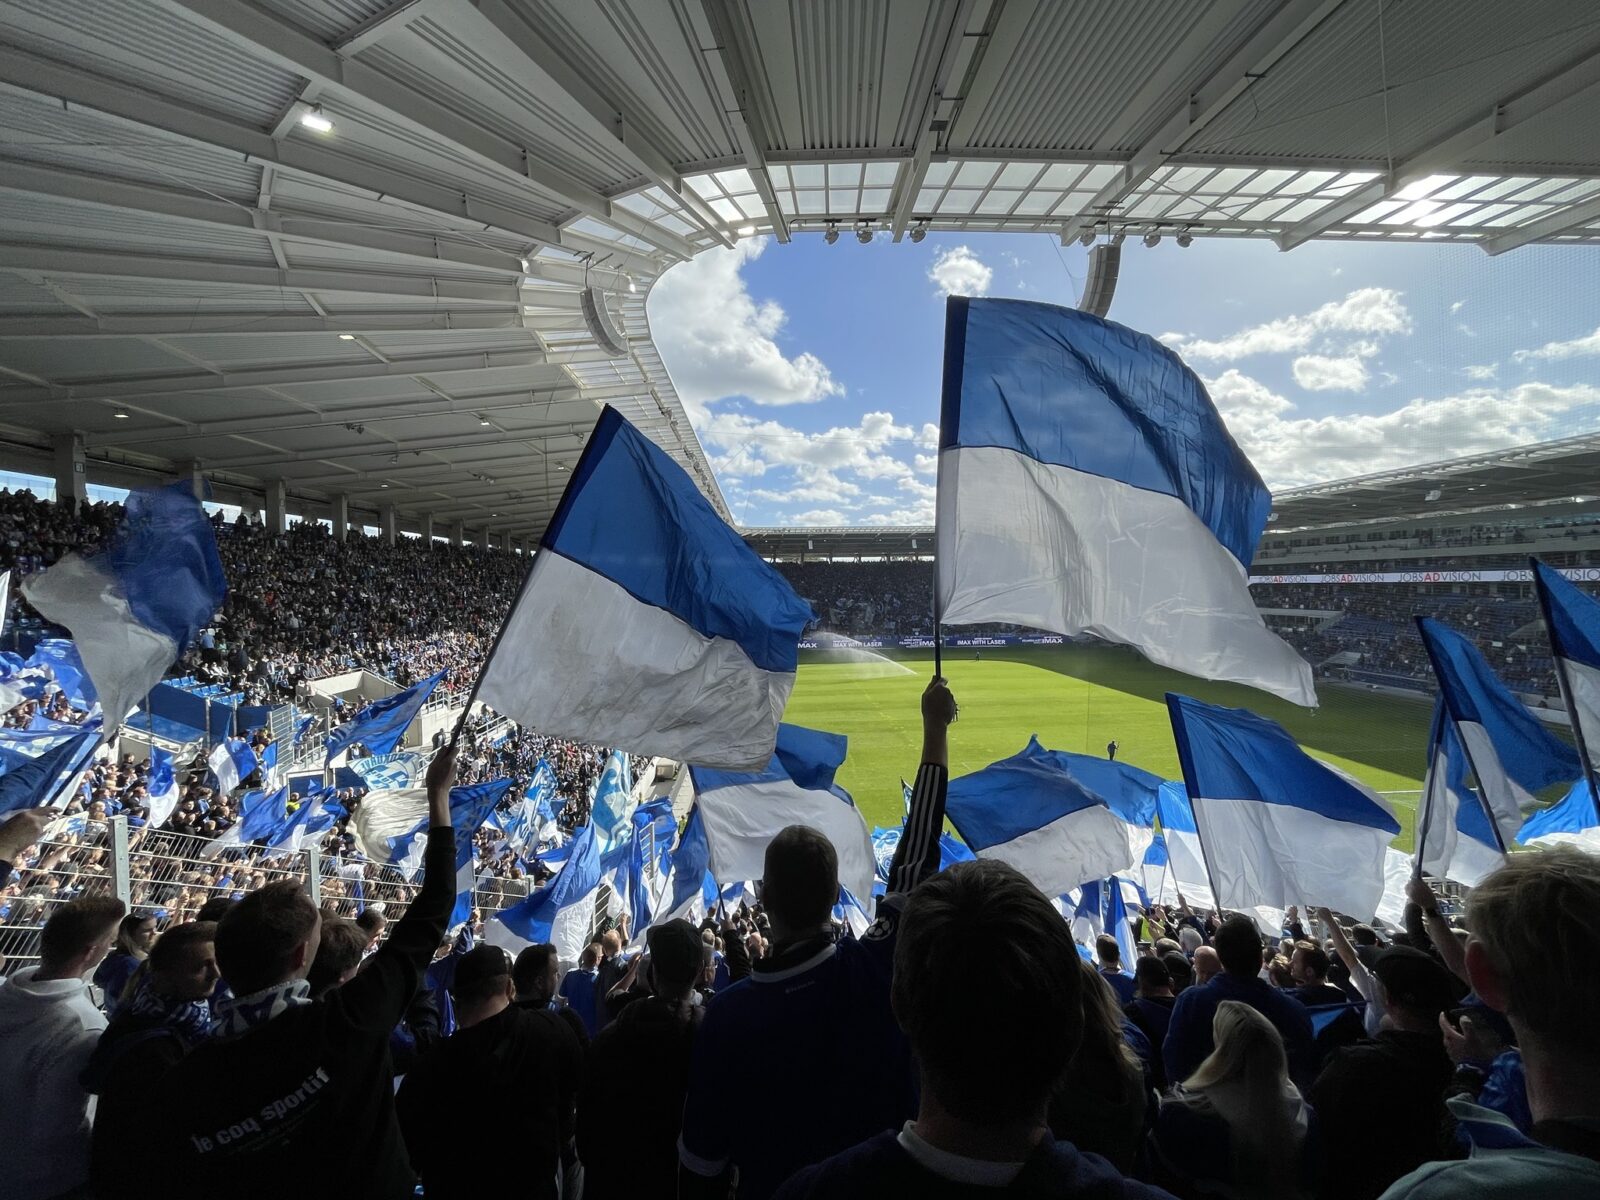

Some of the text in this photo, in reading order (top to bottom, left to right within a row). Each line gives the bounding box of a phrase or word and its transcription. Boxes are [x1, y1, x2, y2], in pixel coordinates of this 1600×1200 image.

[1260, 575, 1308, 583] JOBSADVISION
[1320, 573, 1385, 583] JOBSADVISION
[1398, 571, 1482, 582] JOBSADVISION
[919, 640, 936, 648] IMA
[190, 1133, 214, 1154] le
[216, 1117, 262, 1145] coq
[260, 1066, 330, 1120] sportif
